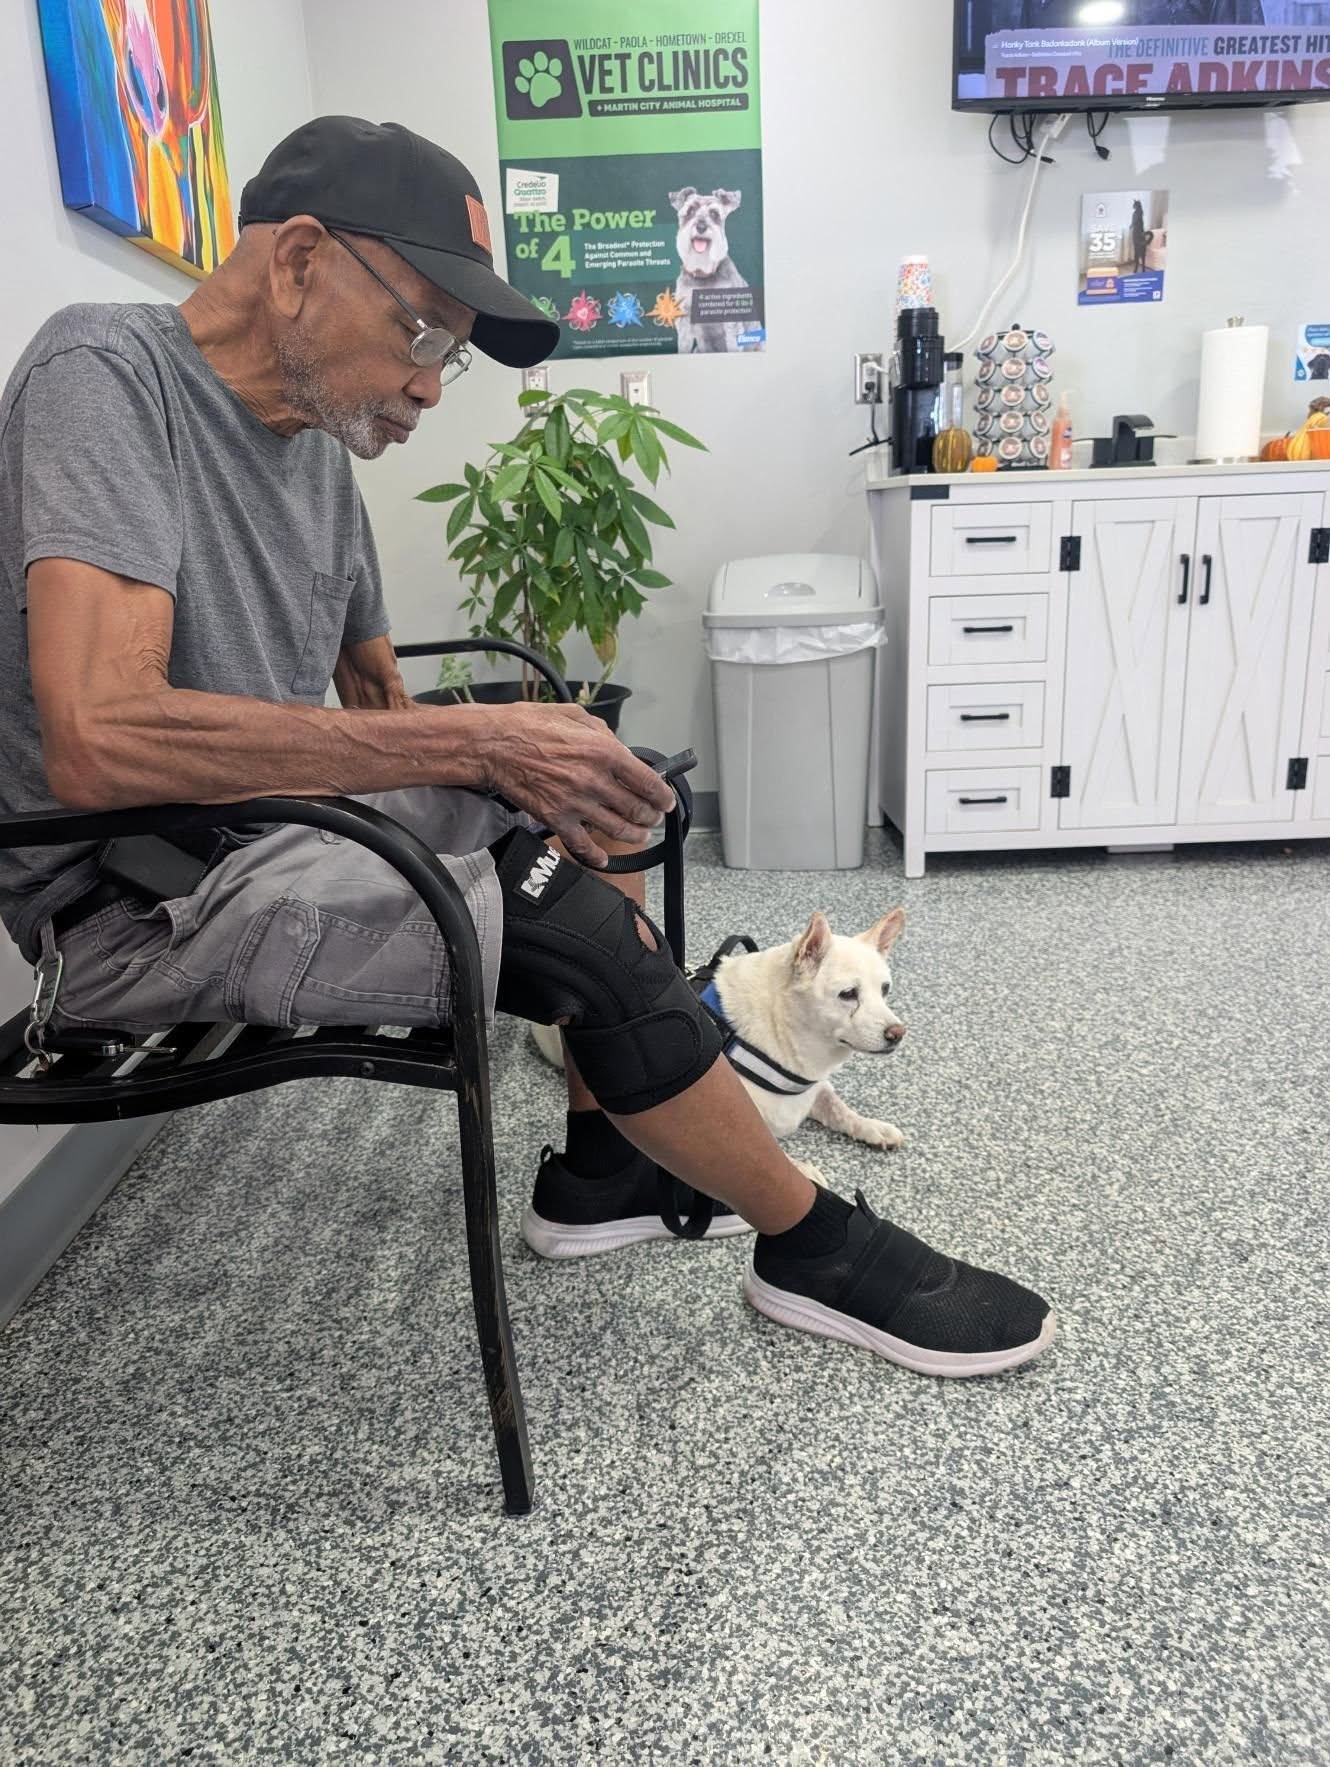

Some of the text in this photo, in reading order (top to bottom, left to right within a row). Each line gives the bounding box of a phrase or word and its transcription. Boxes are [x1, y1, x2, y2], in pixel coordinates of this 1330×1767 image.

[573, 37, 611, 50] WILDCAT
[620, 35, 648, 49] PAOLA
[656, 32, 706, 47] HOMETOWN
[714, 32, 747, 44] DREXEL
[1001, 36, 1139, 50] Honky Tonk Badonkadonk (Album Version)
[1136, 36, 1209, 58] DEFINITIVE
[1214, 34, 1302, 56] GREATEST
[577, 47, 749, 95] VET CLINICS
[996, 63, 1153, 97] TRACE
[603, 102, 639, 112] MARTIN
[640, 101, 661, 110] CITY
[662, 99, 697, 110] ANIMAL
[698, 98, 741, 108] HOSPITAL
[513, 208, 656, 233] The Power
[631, 240, 665, 249] Protection
[1089, 232, 1116, 252] 35
[515, 235, 576, 278] of 4
[584, 252, 609, 260] Against
[585, 258, 671, 270] Emerging Parasite Threats
